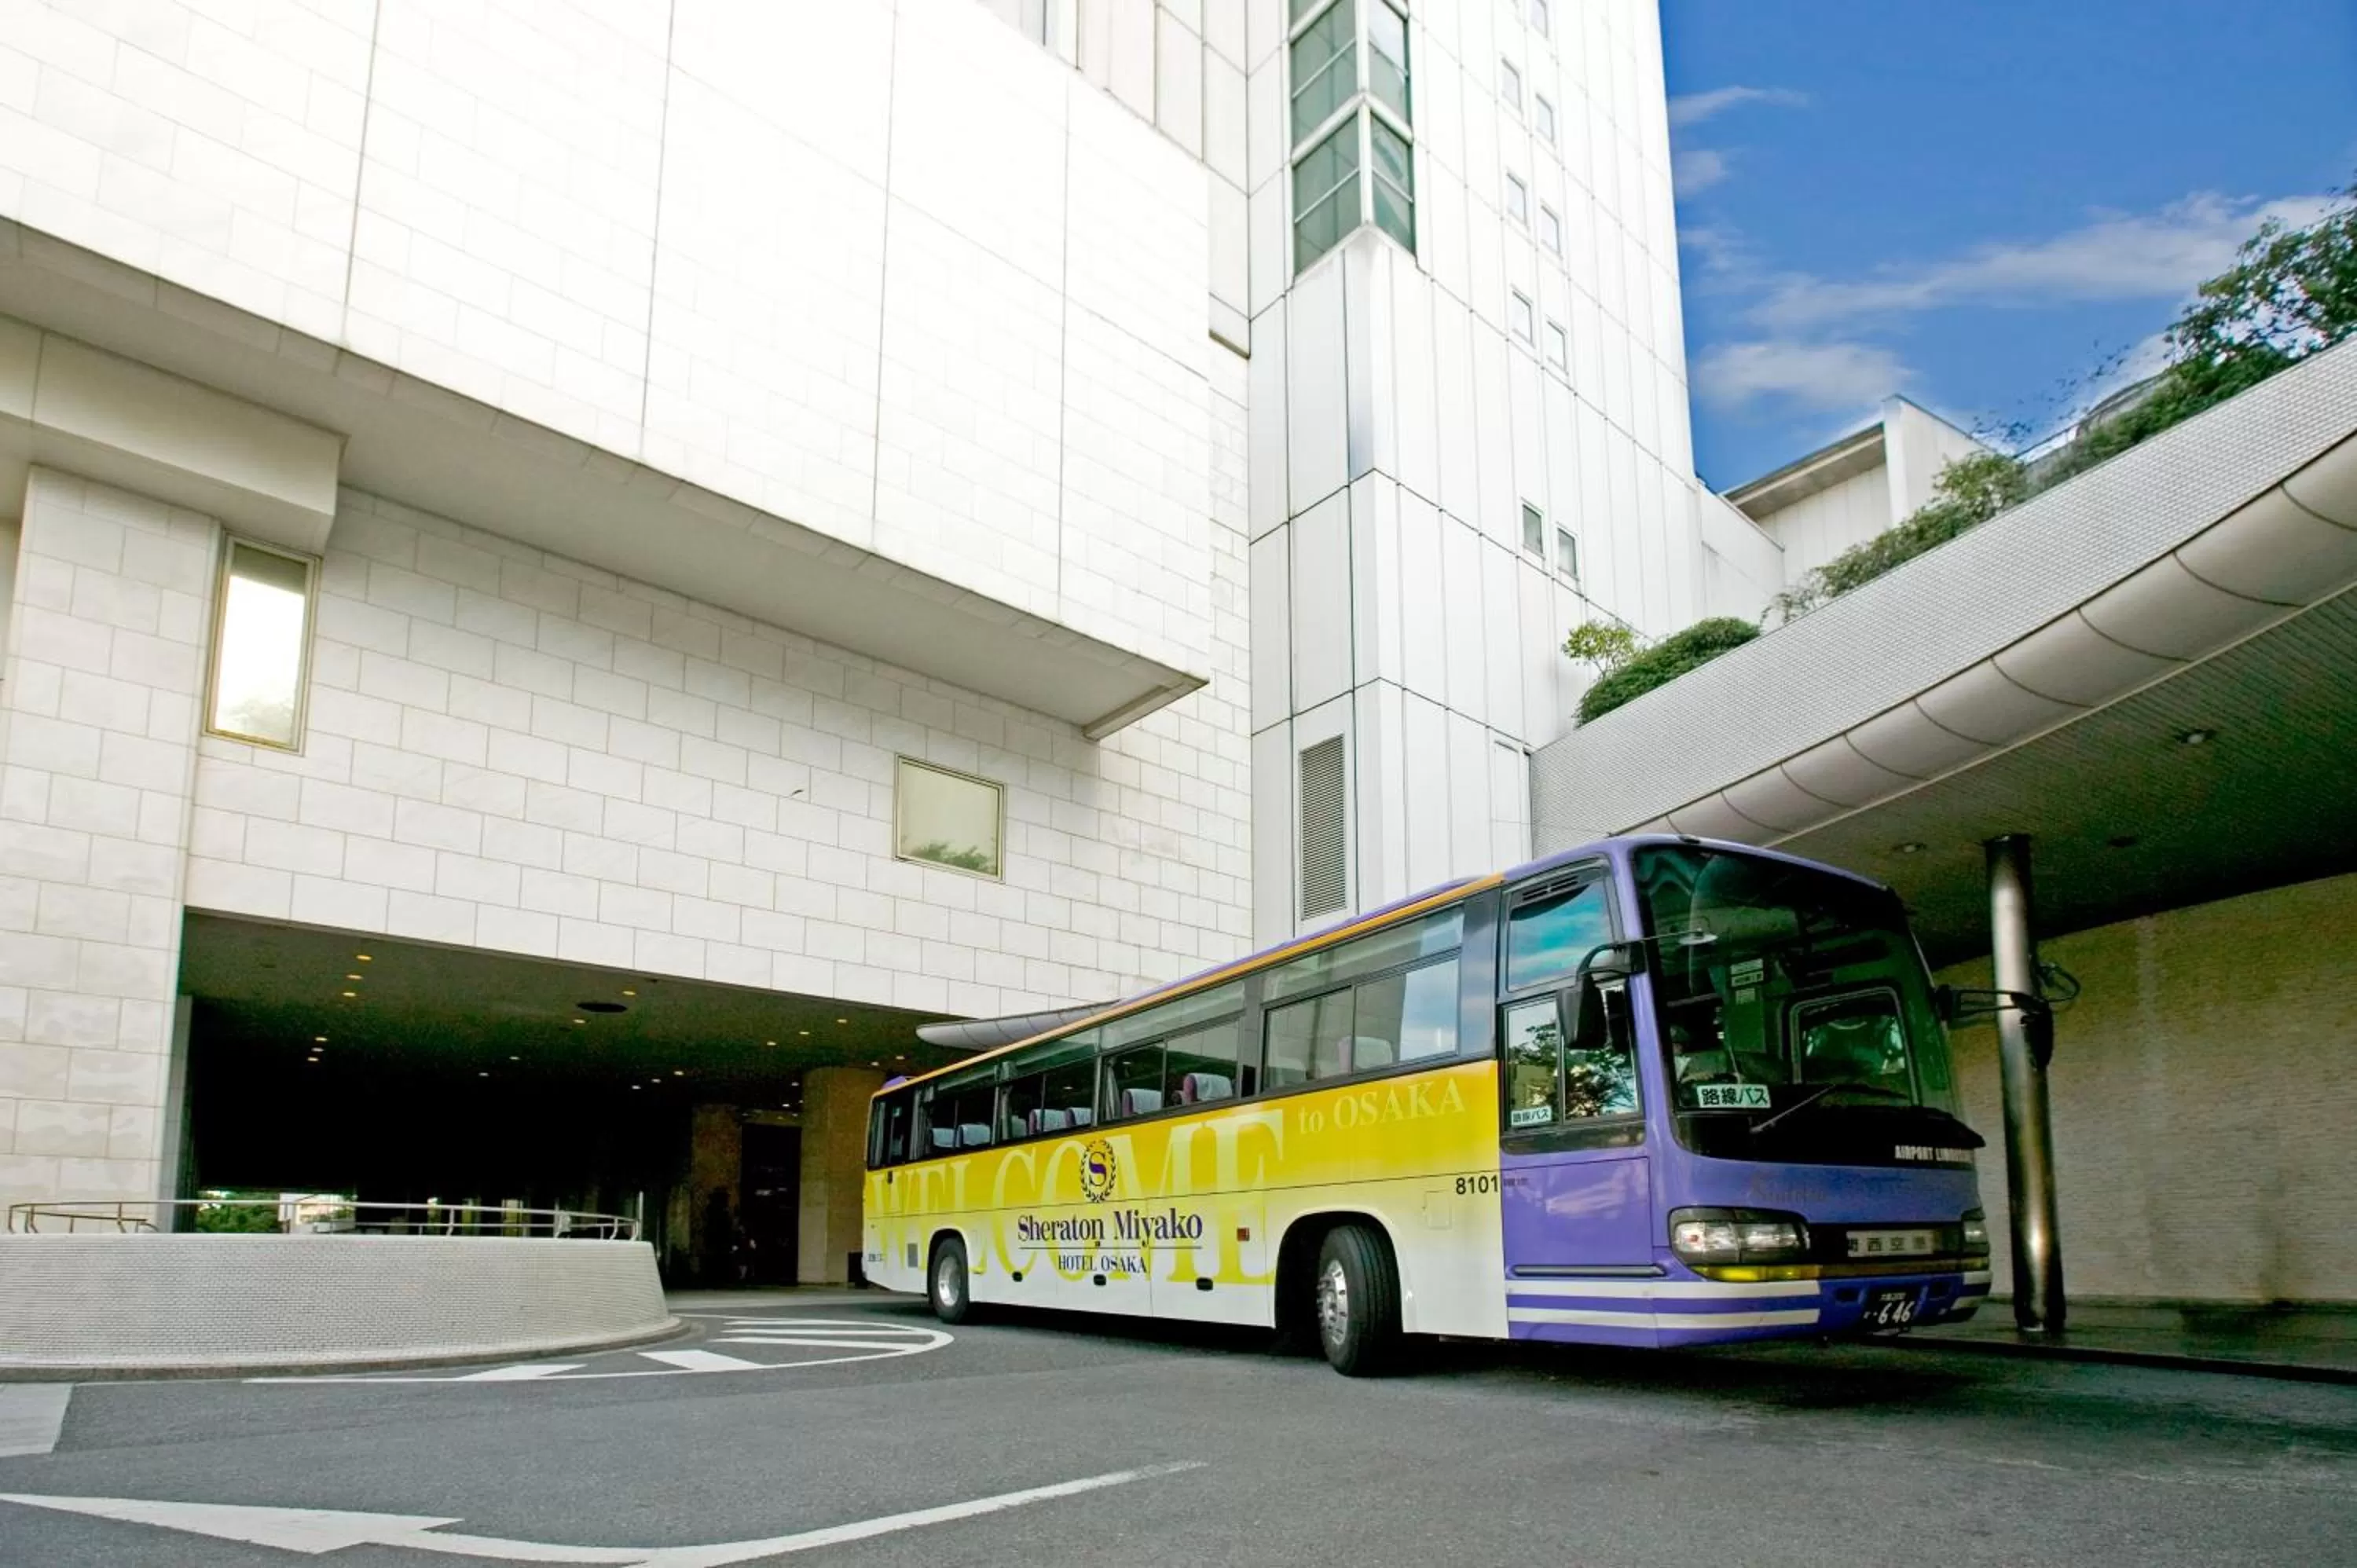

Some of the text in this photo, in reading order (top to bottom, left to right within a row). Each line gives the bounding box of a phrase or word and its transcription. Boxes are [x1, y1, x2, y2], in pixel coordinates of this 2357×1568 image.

[1298, 1077, 1465, 1134] to OSAKA
[1701, 1087, 1768, 1105] 路線バス
[1894, 1145, 1933, 1160] AIRPORT
[1456, 1175, 1498, 1195] 8101
[867, 1108, 1284, 1286] WELCOME
[1017, 1207, 1203, 1247] Sheraton Miyako
[1058, 1255, 1147, 1274] HOTEL OSAKA
